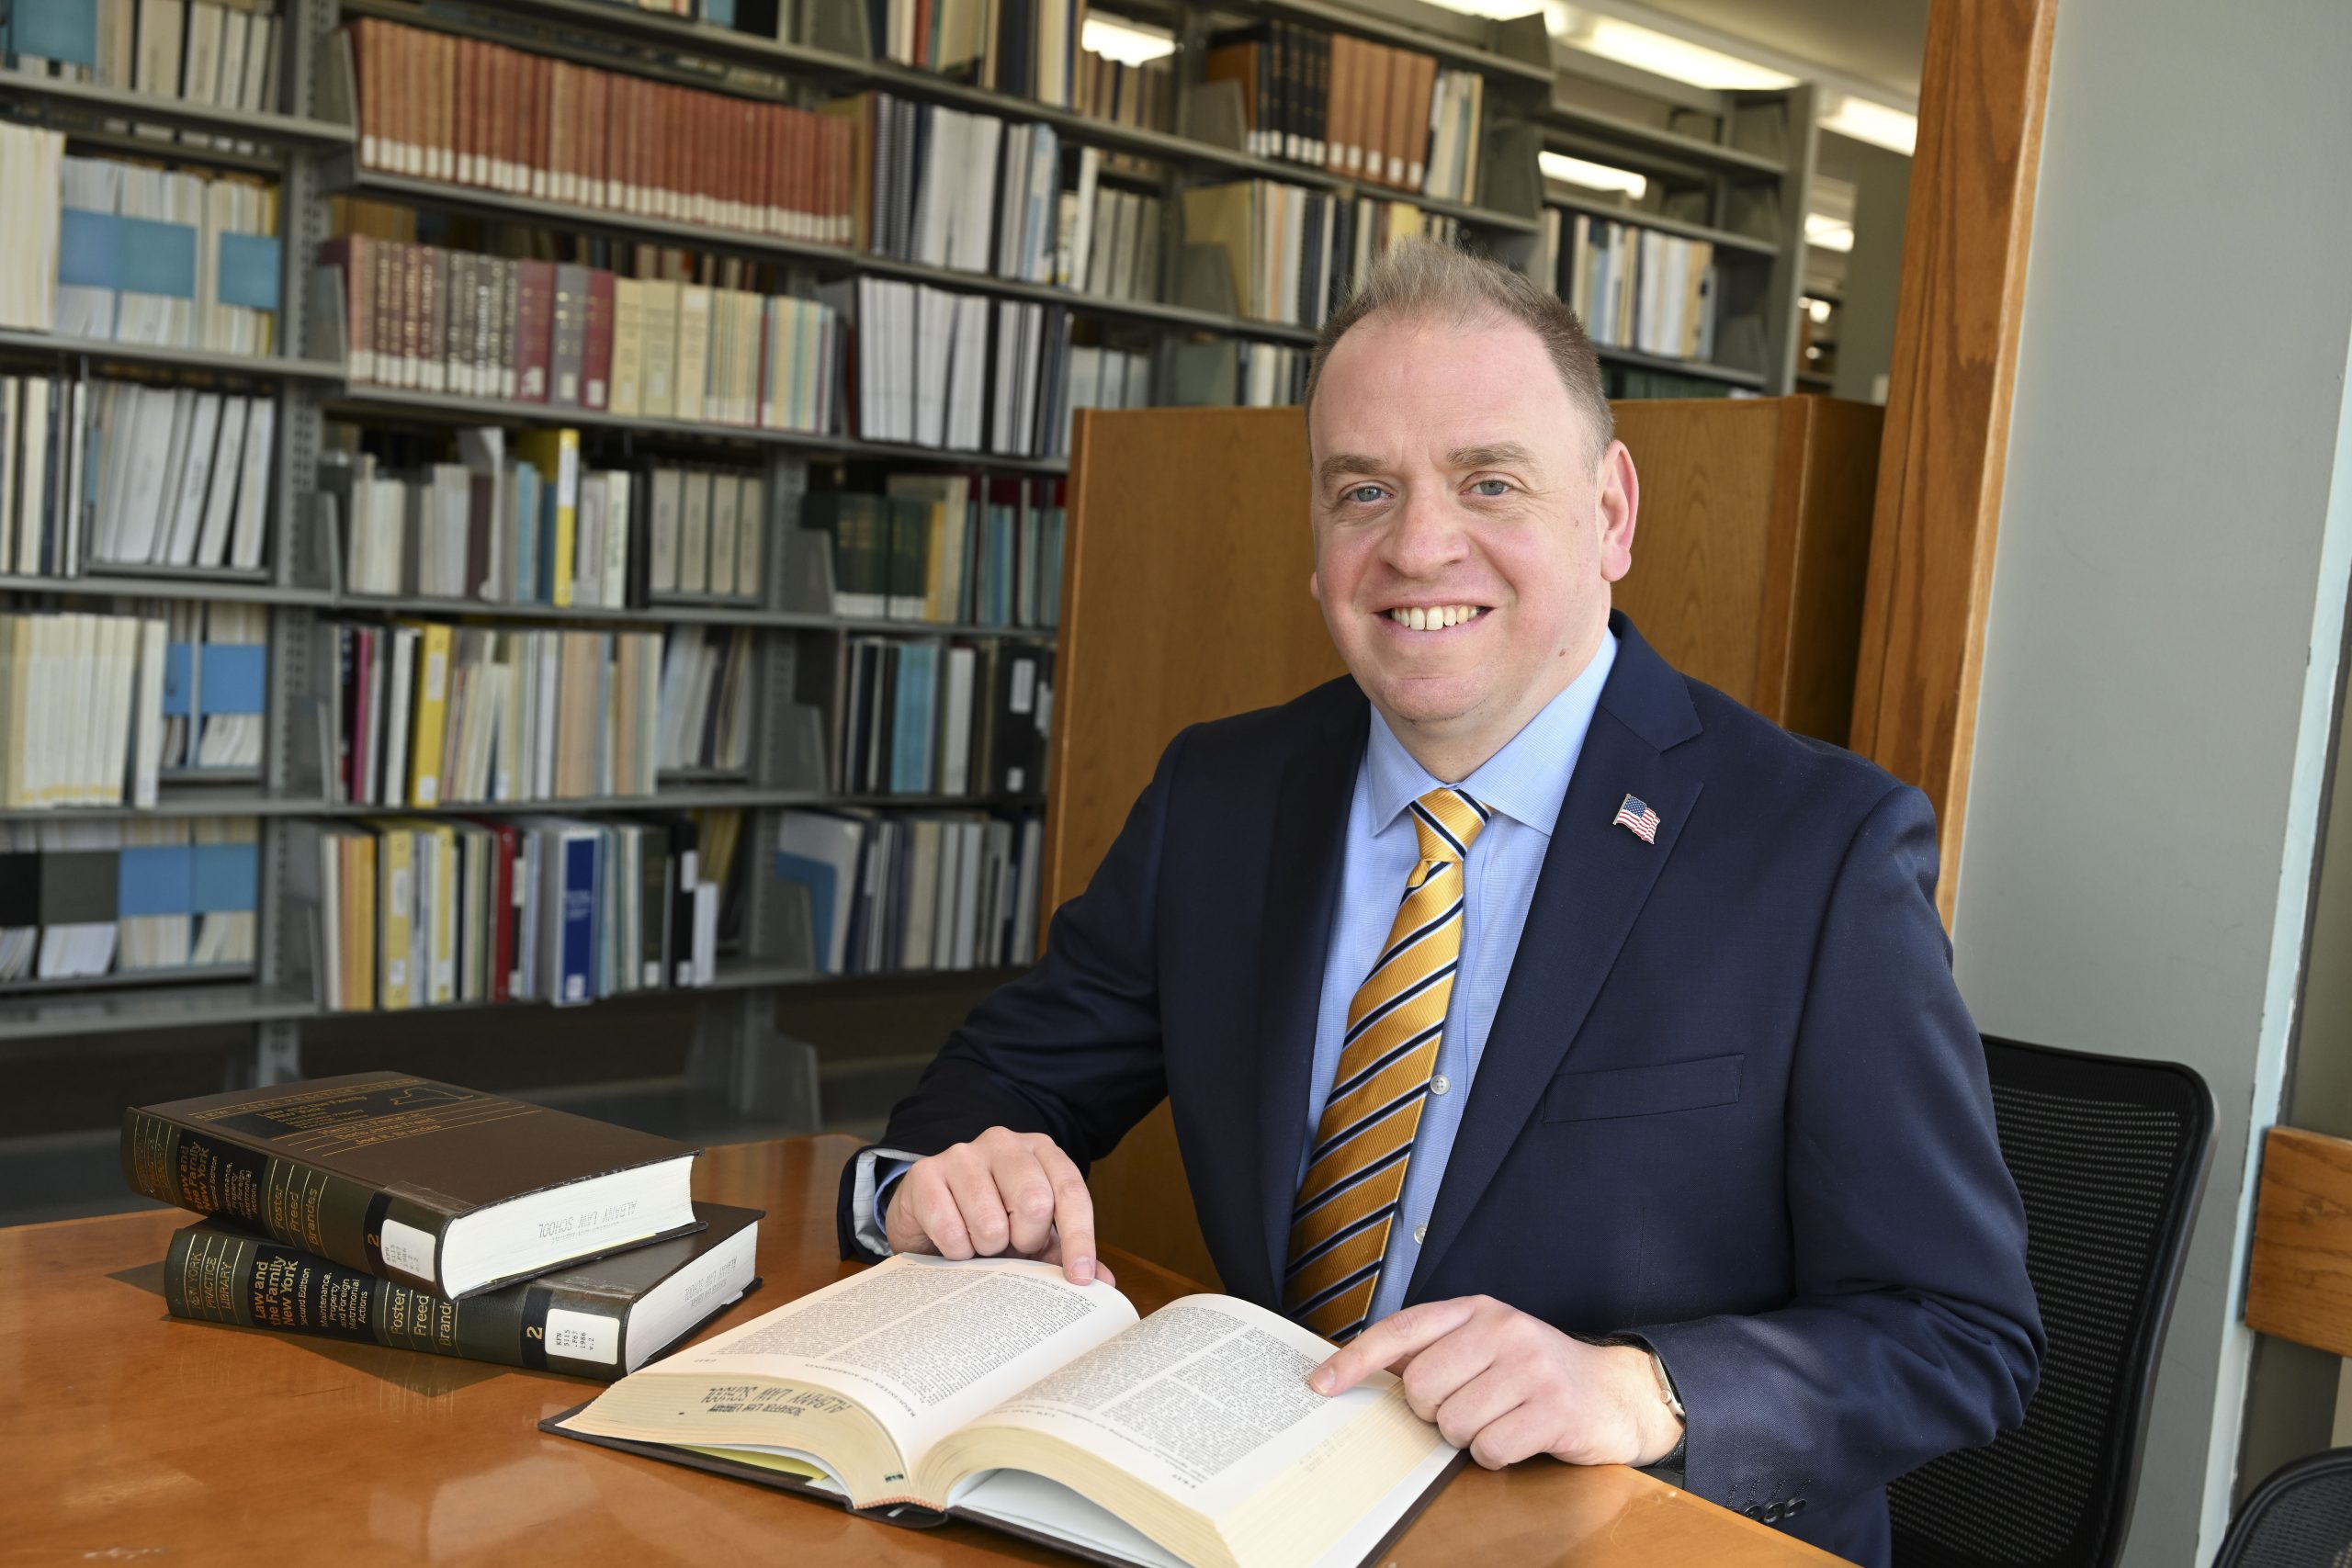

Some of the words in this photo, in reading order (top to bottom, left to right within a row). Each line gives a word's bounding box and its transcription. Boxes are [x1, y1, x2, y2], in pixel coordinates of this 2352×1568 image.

[180, 1145, 189, 1172] and
[188, 1141, 201, 1187] Family
[198, 1147, 210, 1179] York
[199, 1181, 213, 1211] New
[274, 1183, 285, 1230] Foster
[290, 1191, 300, 1232] Freed
[306, 1188, 319, 1246] Brandes
[578, 1211, 598, 1229] LAW
[368, 1234, 379, 1247] 2
[538, 1216, 574, 1238] SCHOOL
[188, 1252, 202, 1282] YORK
[255, 1261, 268, 1289] and
[266, 1256, 286, 1303] Family
[280, 1260, 299, 1293] York
[204, 1257, 217, 1308] PRACTICE
[220, 1261, 232, 1309] LIBRARY
[299, 1268, 311, 1298] Edition
[338, 1279, 350, 1312] Foreign
[254, 1292, 266, 1319] Law
[281, 1297, 295, 1325] New
[299, 1299, 309, 1325] Second
[319, 1272, 332, 1326] Maintenance,
[330, 1282, 340, 1322] Property
[348, 1279, 360, 1330] Matrimonial
[358, 1291, 368, 1324] Actions
[390, 1289, 405, 1334] Foster
[269, 1306, 281, 1325] the
[339, 1313, 347, 1328] and
[413, 1294, 430, 1336] Freed
[526, 1325, 543, 1340] 2
[701, 1386, 758, 1404] SCHOOL
[752, 1387, 795, 1402] LAW
[789, 1392, 854, 1414] ALBANY
